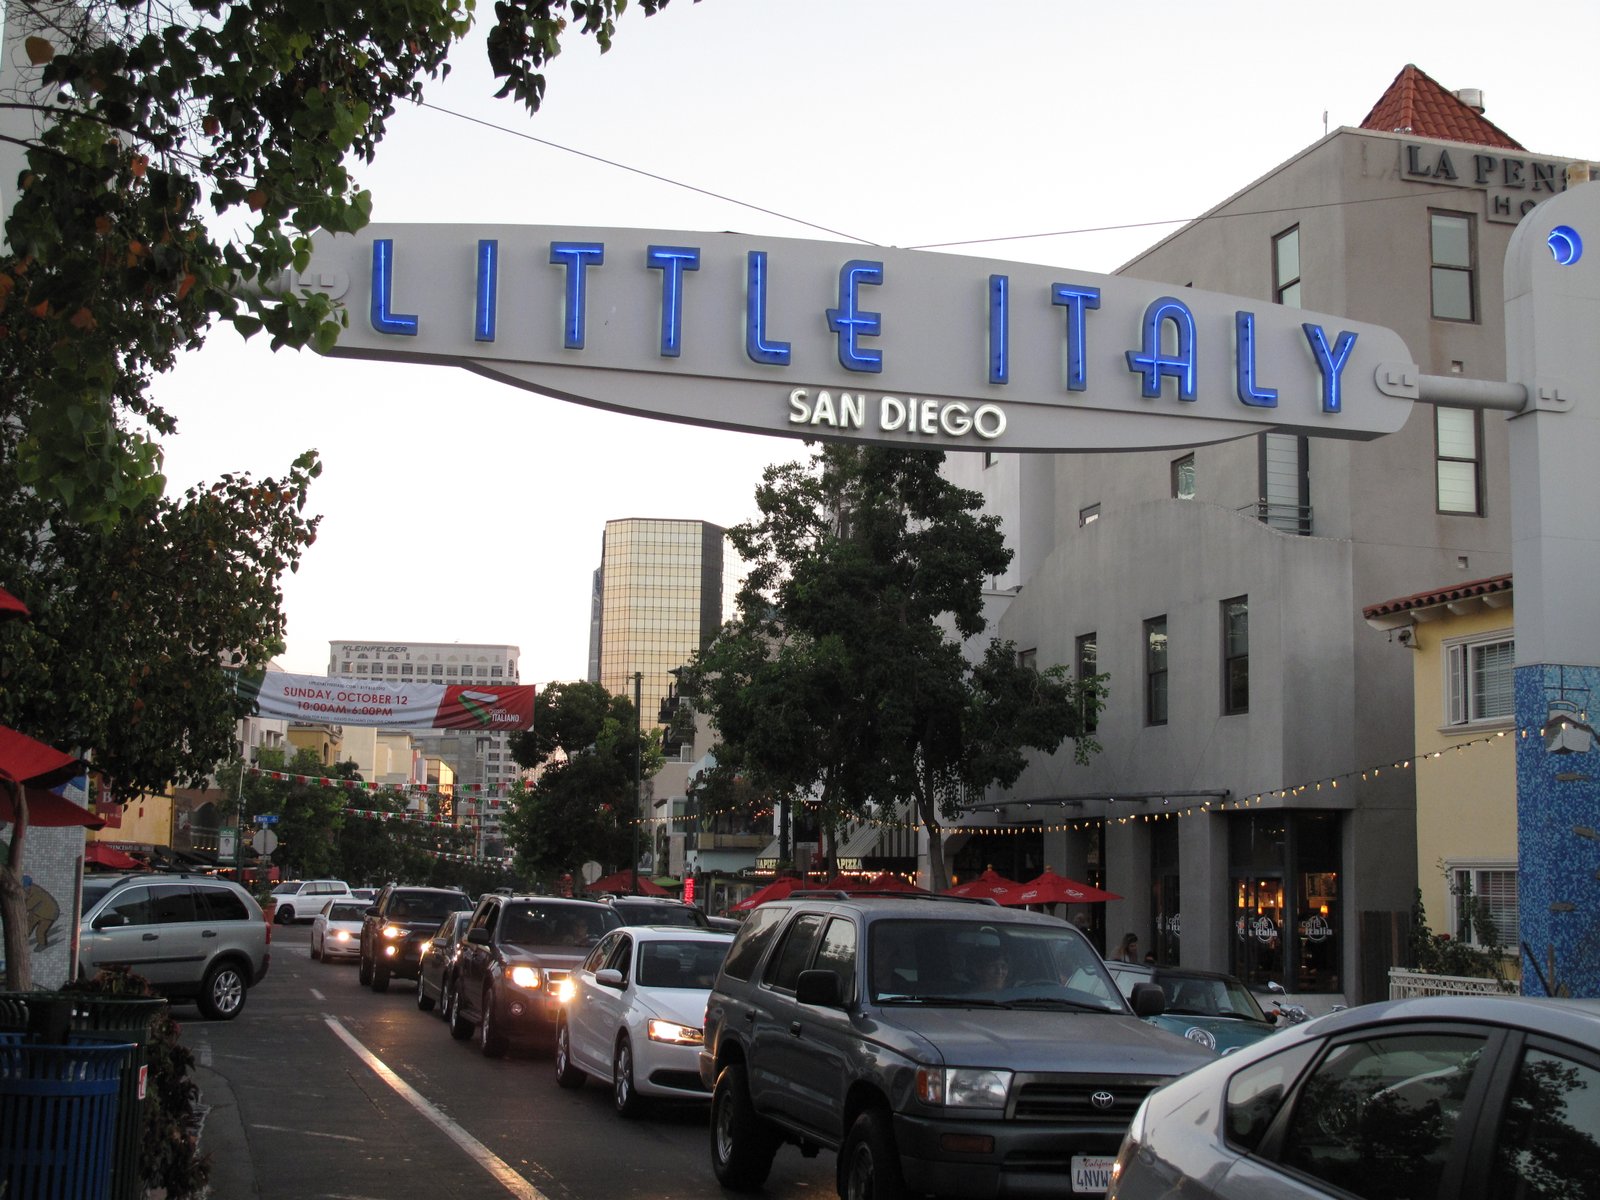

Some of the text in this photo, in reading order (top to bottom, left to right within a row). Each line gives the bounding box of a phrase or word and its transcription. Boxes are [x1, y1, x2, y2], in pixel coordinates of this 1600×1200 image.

[1406, 144, 1458, 180] LA
[370, 238, 1359, 414] LITTLE ITALY
[788, 387, 1008, 440] SAN DIEGO
[342, 645, 408, 653] KLEINFELDER
[284, 686, 408, 705] SUNDAY, OCTOBER 12
[492, 713, 520, 722] ITALIANO
